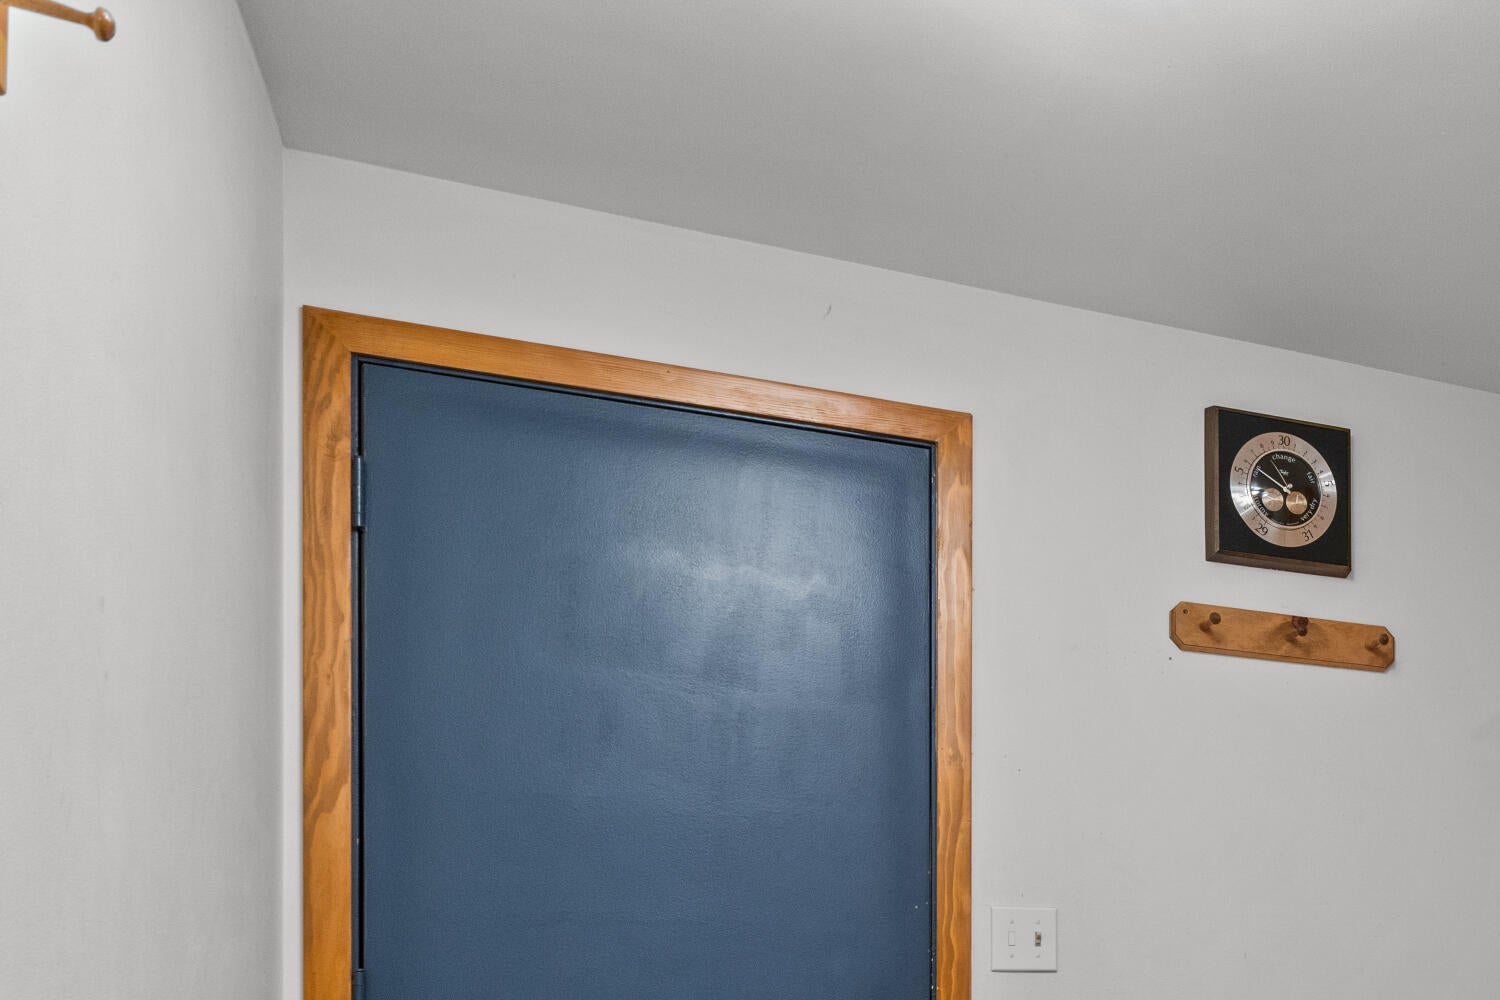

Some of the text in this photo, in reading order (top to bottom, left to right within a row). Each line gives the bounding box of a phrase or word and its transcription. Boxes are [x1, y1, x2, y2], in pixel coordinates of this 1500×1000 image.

[1278, 434, 1290, 447] 30
[1272, 453, 1296, 463] change
[1309, 497, 1320, 510] dry
[1255, 523, 1269, 536] 29
[1302, 529, 1314, 542] 31
